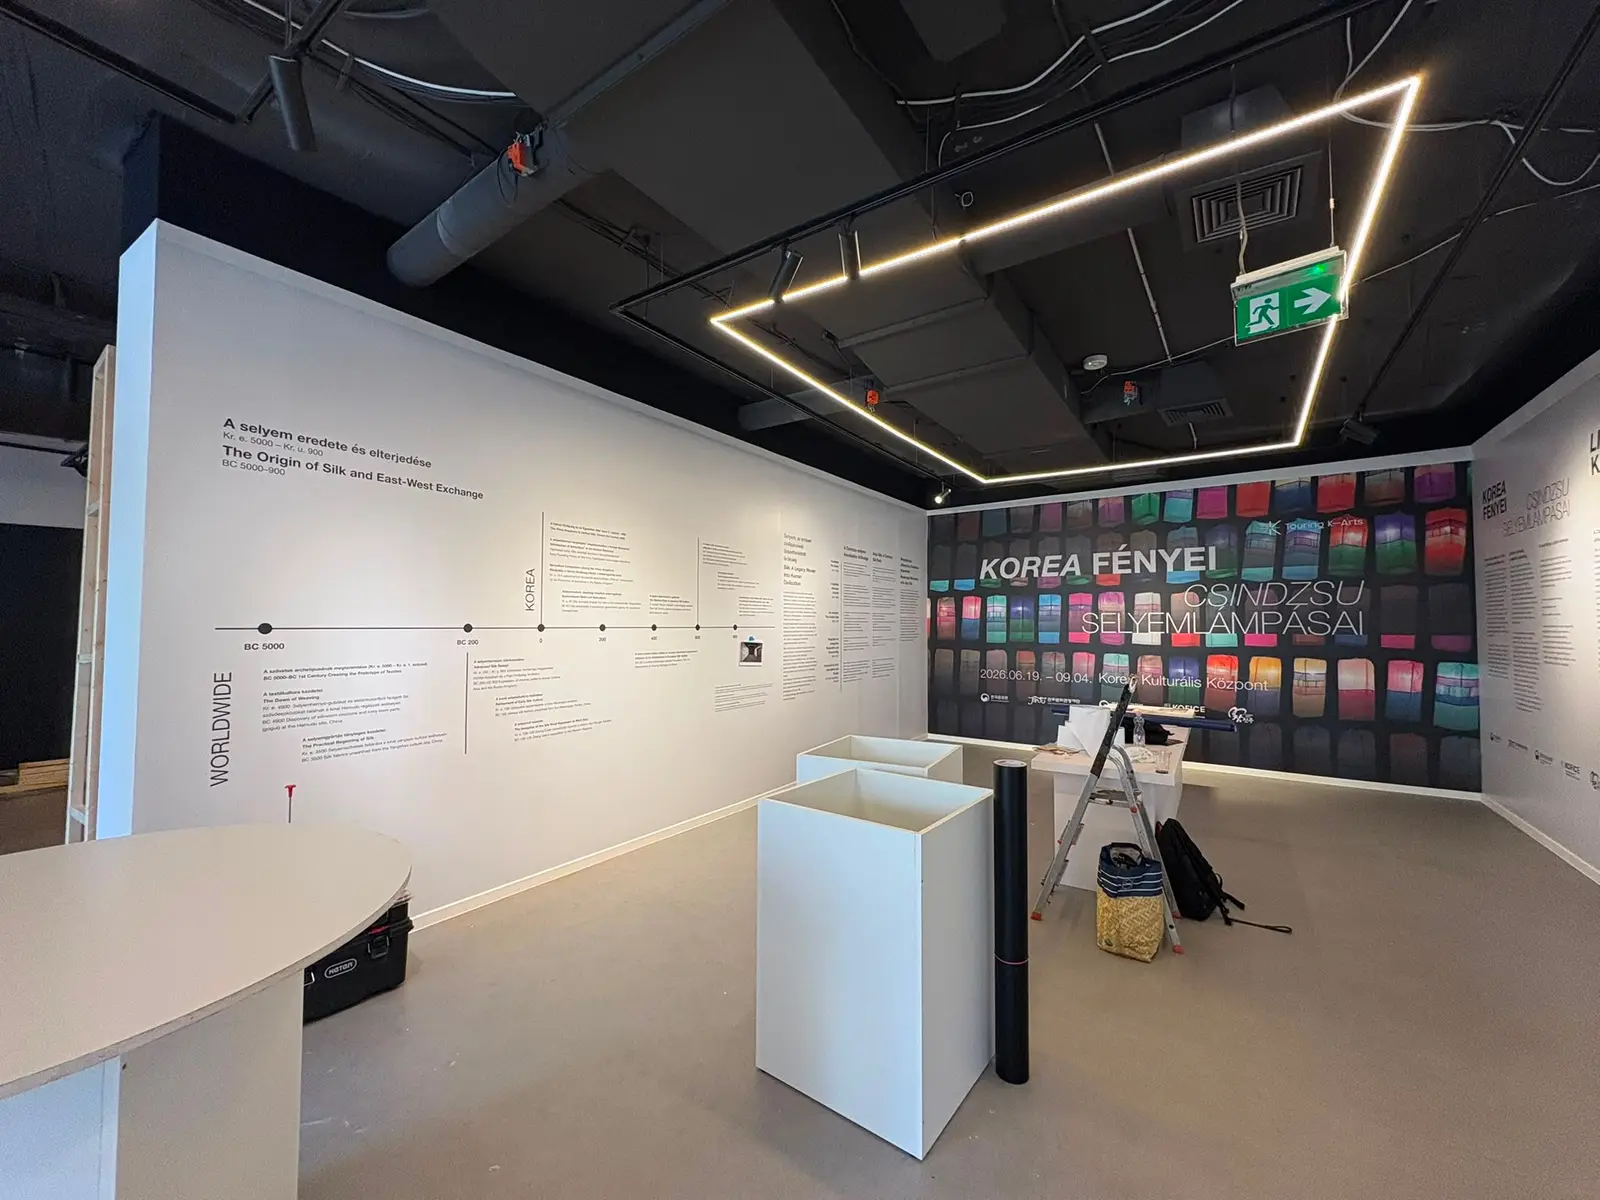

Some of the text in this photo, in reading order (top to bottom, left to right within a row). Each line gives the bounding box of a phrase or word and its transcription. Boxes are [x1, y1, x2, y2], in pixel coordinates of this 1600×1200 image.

[223, 418, 432, 469] A selyem eredete és elterjedése
[223, 431, 236, 441] Kr.
[250, 437, 274, 448] 5000
[283, 443, 296, 452] Kr.
[308, 447, 324, 457] 900
[222, 459, 238, 469] BC
[222, 444, 484, 500] The Origin of Silk and East-West Exchange
[1482, 480, 1506, 504] KOREA
[980, 544, 1216, 580] KOREA FÉNYEI
[525, 568, 535, 612] KOREA
[1184, 580, 1365, 608] CSINDZSU
[1082, 606, 1364, 636] SELYEMLÁMPÁSAI
[262, 642, 285, 650] 5000
[980, 669, 1042, 681] 2026.06.19.
[1056, 672, 1092, 684] 09.04.
[1142, 674, 1202, 688] Kulturális
[1207, 677, 1268, 692] Központ
[210, 672, 232, 787] WORLDWIDE
